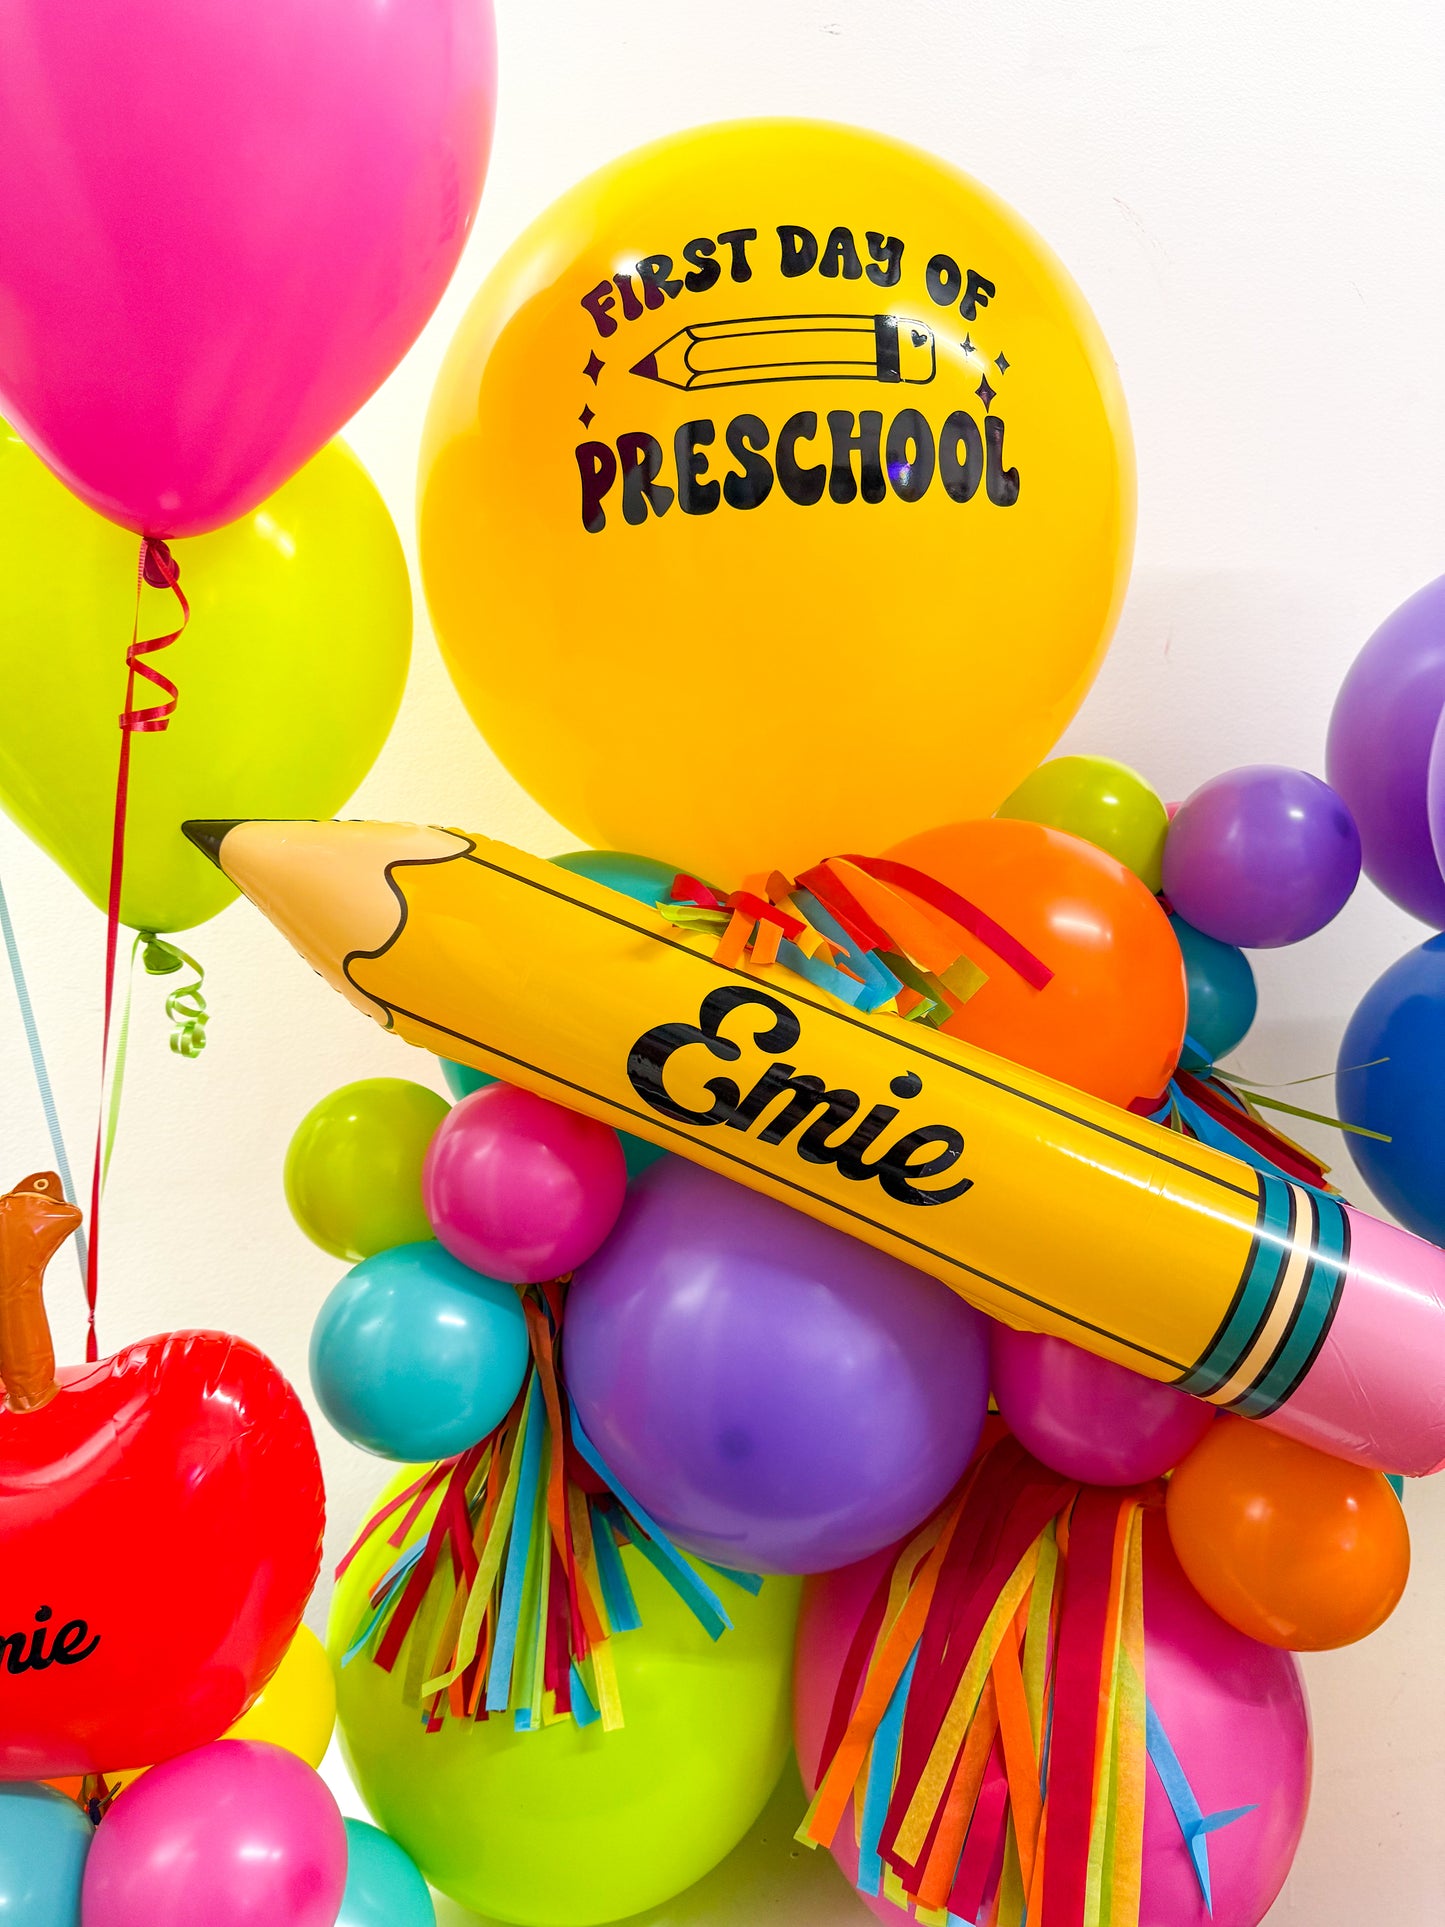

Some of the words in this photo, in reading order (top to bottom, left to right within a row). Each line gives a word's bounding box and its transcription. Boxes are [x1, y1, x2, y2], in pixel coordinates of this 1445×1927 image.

[580, 228, 758, 338] FIRST
[776, 225, 905, 288] DAY
[925, 253, 996, 321] OF
[575, 408, 1020, 534] PRESCHOOL
[627, 985, 974, 1207] Emie
